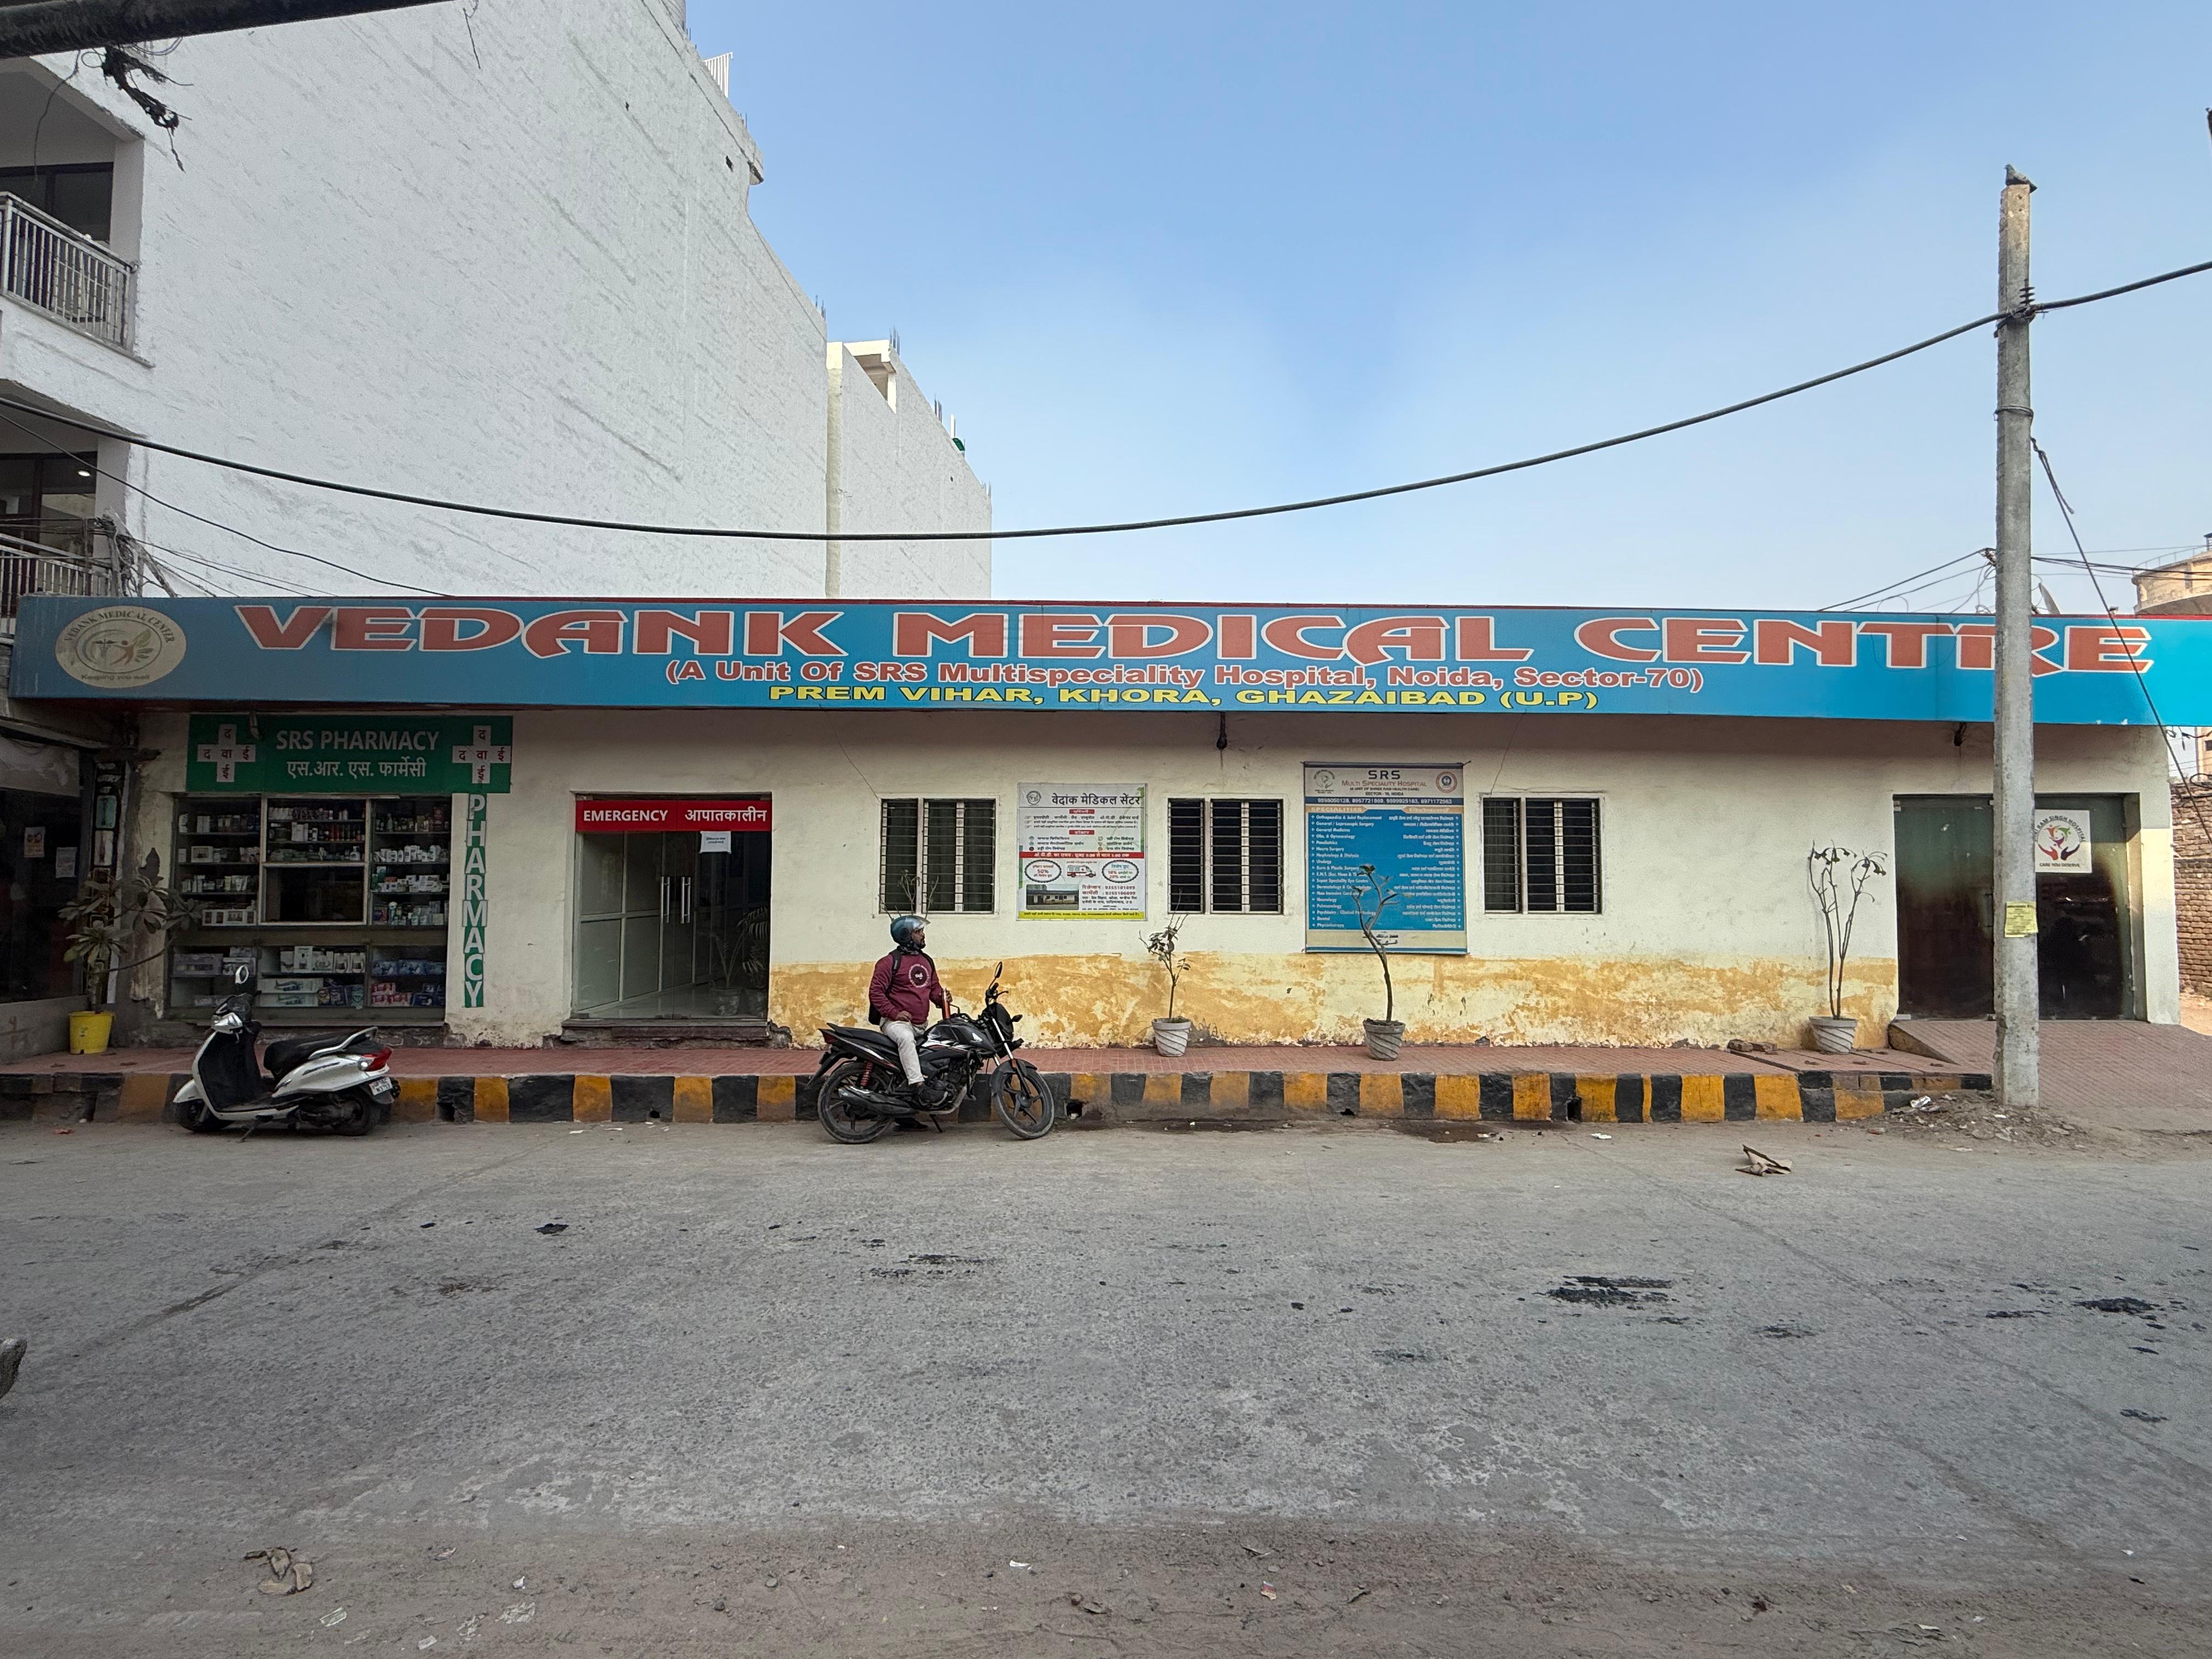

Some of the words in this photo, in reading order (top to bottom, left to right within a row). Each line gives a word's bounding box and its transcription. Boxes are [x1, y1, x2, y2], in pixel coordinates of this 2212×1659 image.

[63, 617, 98, 641] VEDANK
[99, 610, 148, 622] MEDICAL
[234, 605, 849, 658] VEDANK
[893, 611, 1534, 666] MEDICAL
[1573, 616, 2154, 677] CENTRE
[665, 660, 706, 684] (A
[715, 661, 791, 682] Unit
[800, 661, 844, 681] Of
[853, 663, 928, 682] SRS
[938, 663, 1206, 689] Multispeciality
[1216, 665, 1376, 689] Hospital,
[1386, 665, 1503, 690] Noida,
[1514, 667, 1704, 693] Sector-70)
[769, 686, 886, 701] PREM
[899, 687, 1045, 706] VIHAR,
[1059, 687, 1222, 706] KHORA,
[1235, 689, 1487, 706] GHAZAIBAD
[1499, 691, 1599, 709] (U.P)
[276, 730, 313, 750] SRS
[320, 731, 438, 751] PHARMACY
[348, 760, 374, 778] एस.
[379, 755, 426, 778] फार्मेसी
[1368, 770, 1401, 780] SRS
[1052, 792, 1077, 805] वेदांक
[1081, 792, 1117, 805] मेडिकल
[1120, 792, 1141, 805] सेंटर
[583, 810, 668, 822] EMERGENCY
[685, 806, 768, 822] आपातकालीन
[2036, 818, 2049, 829] RAM
[2068, 819, 2086, 842] HOSPITAL
[464, 793, 487, 1007] PHARMACY
